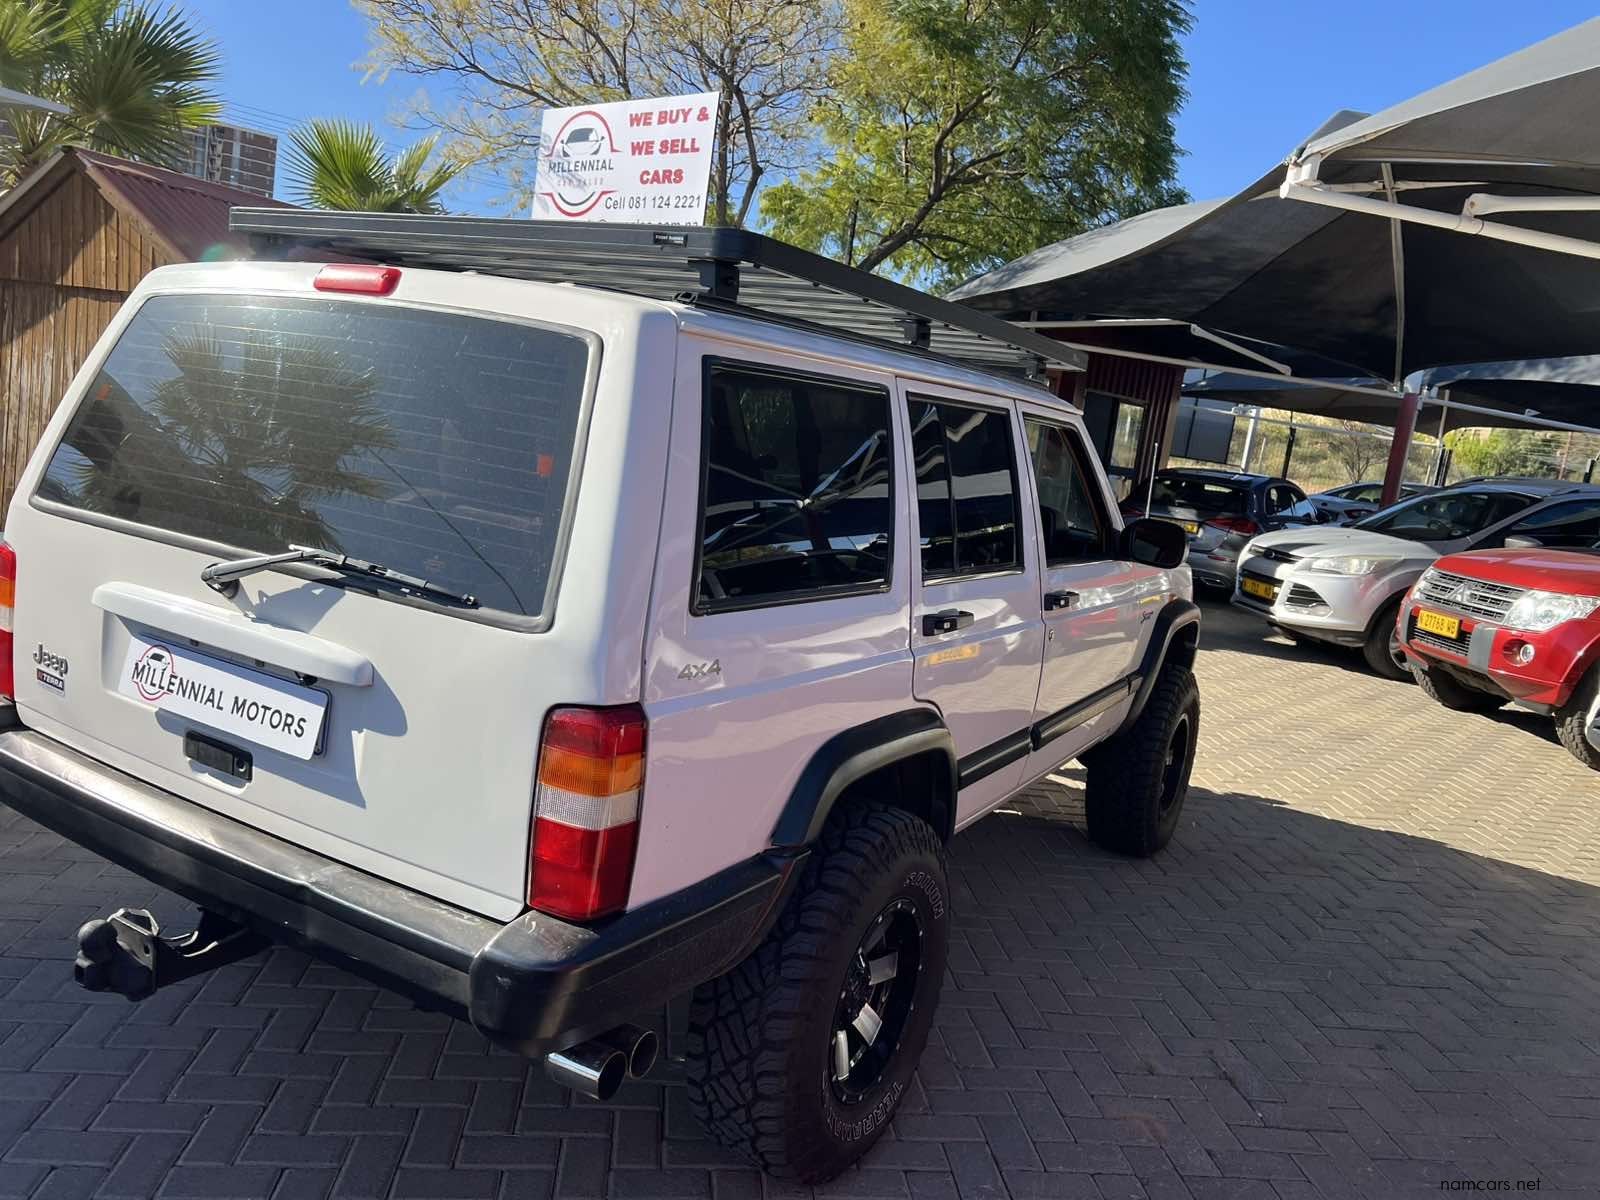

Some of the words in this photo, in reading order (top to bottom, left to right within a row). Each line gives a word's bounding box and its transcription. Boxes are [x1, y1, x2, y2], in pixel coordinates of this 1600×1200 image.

[629, 113, 654, 127] WE
[657, 108, 692, 125] BUY
[697, 106, 710, 122] &
[631, 141, 654, 156] WE
[658, 138, 700, 154] SELL
[548, 159, 614, 173] MILLENNIAL
[639, 168, 684, 185] CARS
[605, 196, 625, 210] Cell
[629, 196, 647, 209] 081
[652, 196, 671, 209] 124
[674, 195, 701, 209] 2221
[33, 643, 68, 677] Jeep
[131, 662, 224, 711] MILLENNIAL
[231, 696, 307, 738] MOTORS
